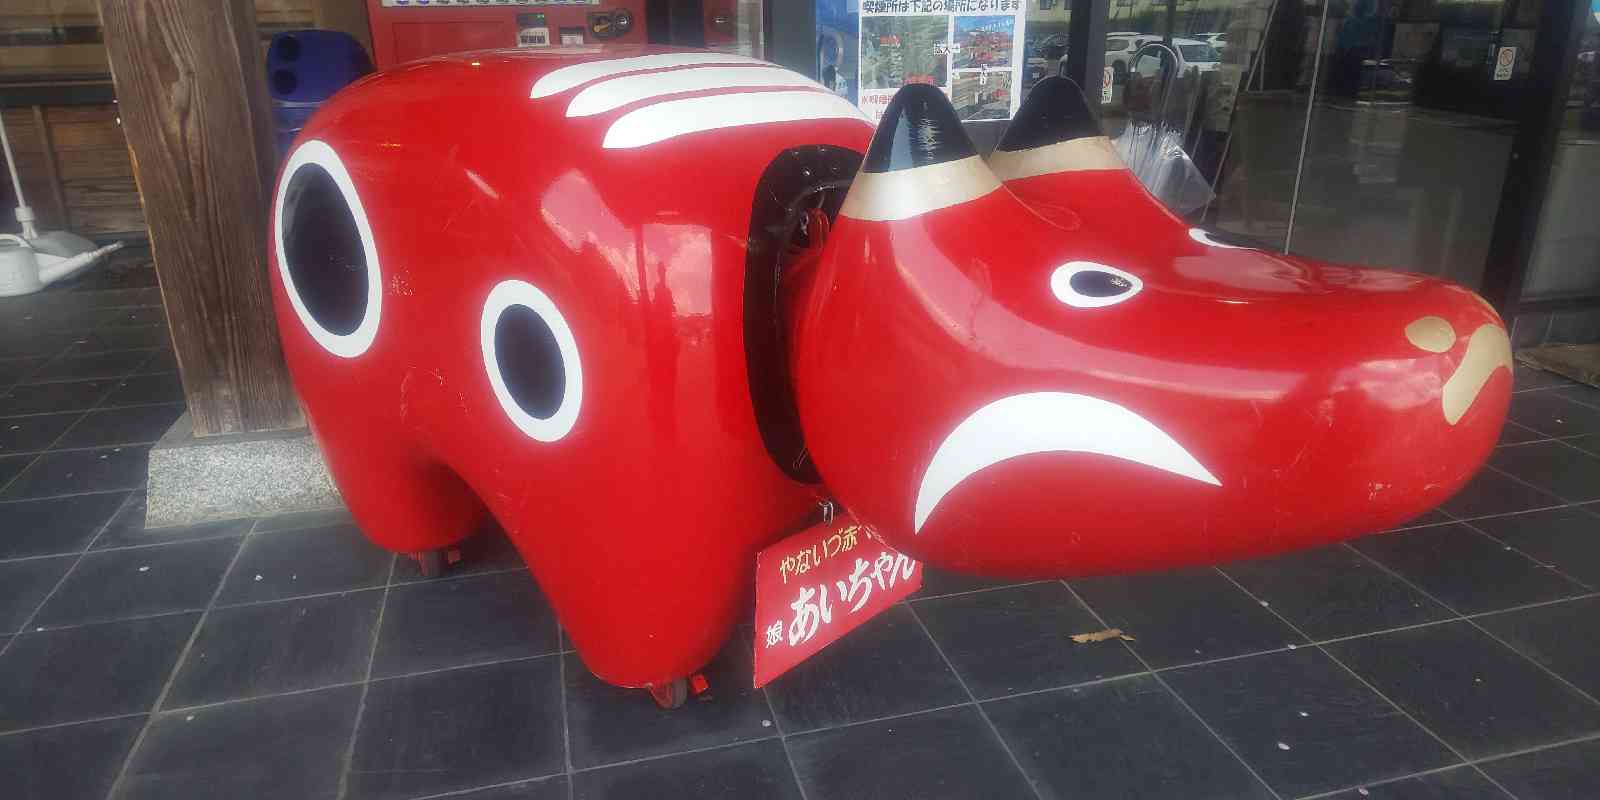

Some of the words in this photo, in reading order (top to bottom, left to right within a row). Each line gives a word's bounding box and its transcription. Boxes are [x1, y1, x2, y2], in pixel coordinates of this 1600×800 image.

[766, 620, 783, 648] 娘
[788, 551, 916, 647] あいちゃん
